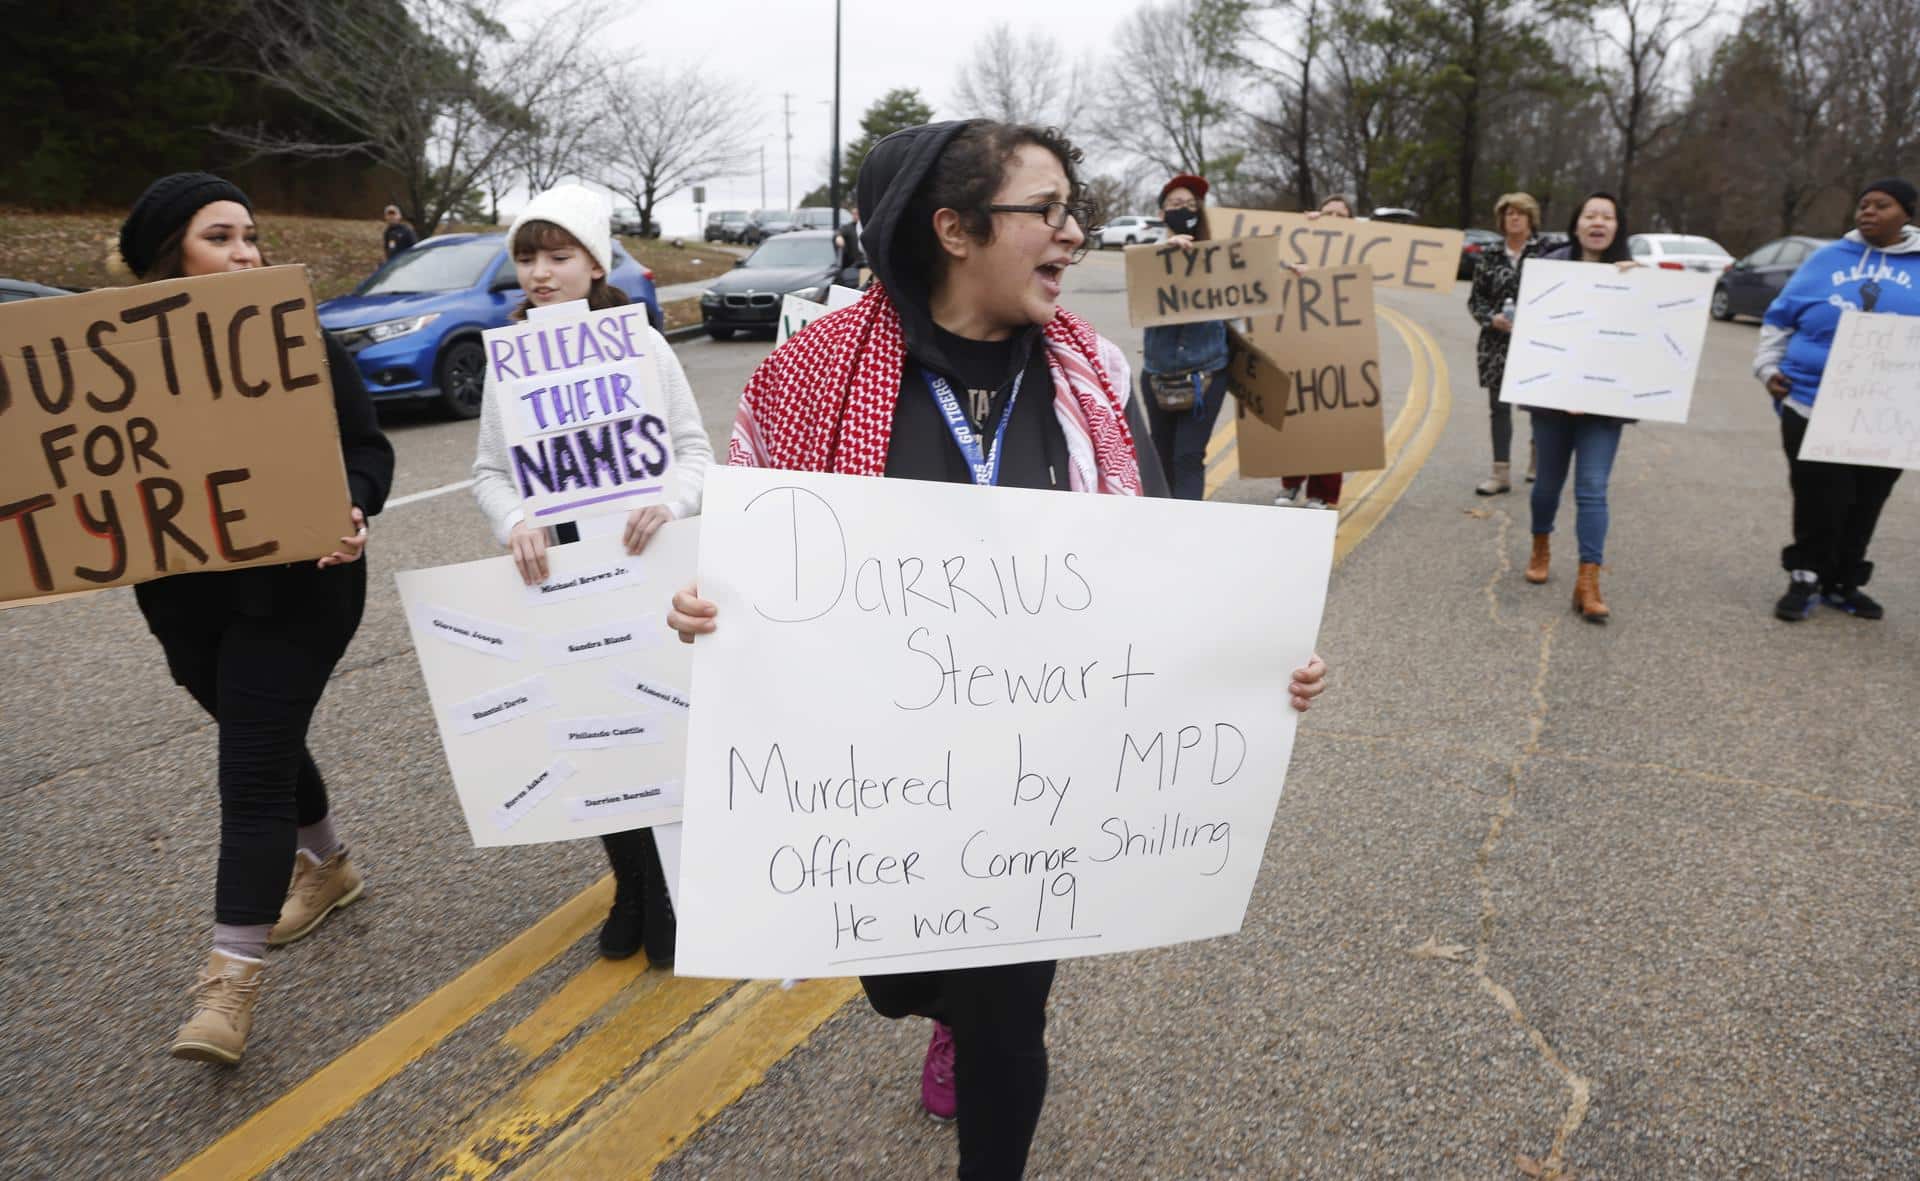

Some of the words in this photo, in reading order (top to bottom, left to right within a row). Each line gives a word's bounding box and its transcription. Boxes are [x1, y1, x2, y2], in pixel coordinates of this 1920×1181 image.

[1157, 281, 1268, 315] NICHOLS
[490, 312, 645, 382] RELEASE
[520, 373, 640, 430] THEIR
[932, 377, 964, 425] TIGERS
[40, 416, 171, 489] FOR
[510, 414, 669, 499] NAMES
[954, 426, 974, 445] GO
[0, 467, 279, 593] TYRE
[541, 579, 577, 593] Michael
[578, 572, 611, 585] Brown
[568, 641, 602, 653] Sandra
[604, 633, 632, 645] Bland
[893, 626, 1156, 711] Stewart
[568, 730, 610, 740] Philando
[729, 743, 952, 817] Murdered
[1012, 733, 1071, 826] by
[1115, 722, 1247, 793] MPD
[1088, 812, 1231, 876] Shilling
[833, 901, 884, 950] He
[913, 904, 999, 938] was
[1035, 872, 1077, 933] 19
